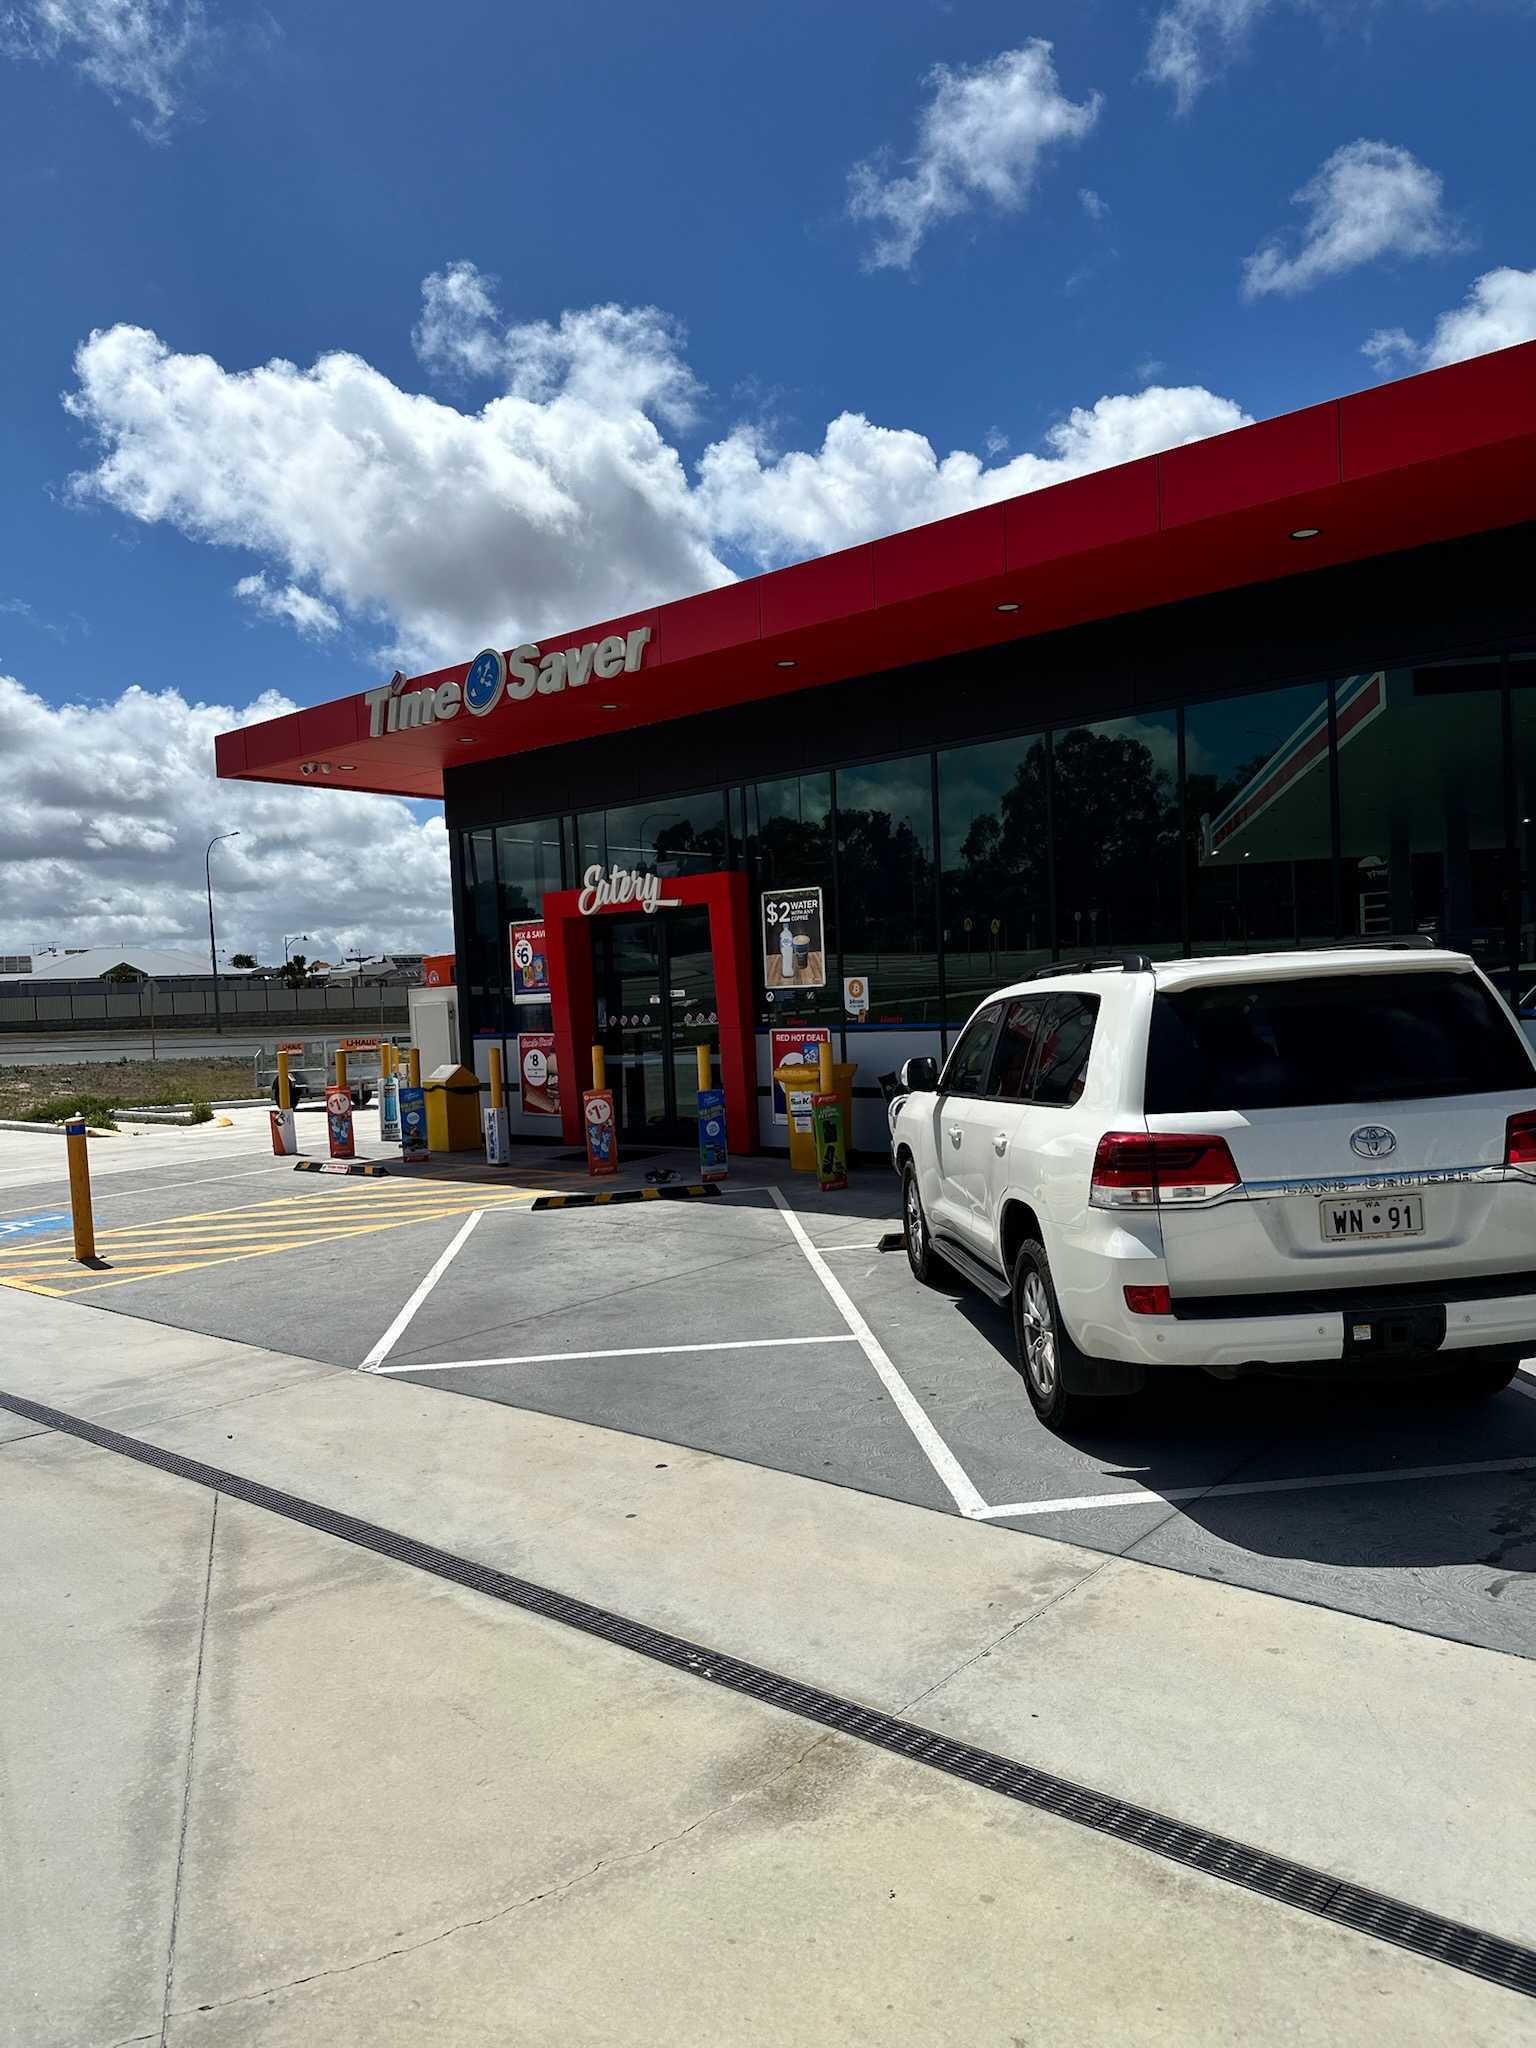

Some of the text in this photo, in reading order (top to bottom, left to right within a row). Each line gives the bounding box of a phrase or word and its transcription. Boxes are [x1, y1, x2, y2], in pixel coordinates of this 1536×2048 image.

[365, 626, 651, 738] Time Saver
[578, 863, 682, 916] Eatery
[766, 899, 818, 926] $2 WATER
[531, 929, 546, 939] SAV
[516, 946, 530, 965] $6
[775, 1033, 825, 1042] RED HOT DEAL
[1282, 1172, 1472, 1196] LAND CRUISER
[1332, 1205, 1413, 1234] WN 91
